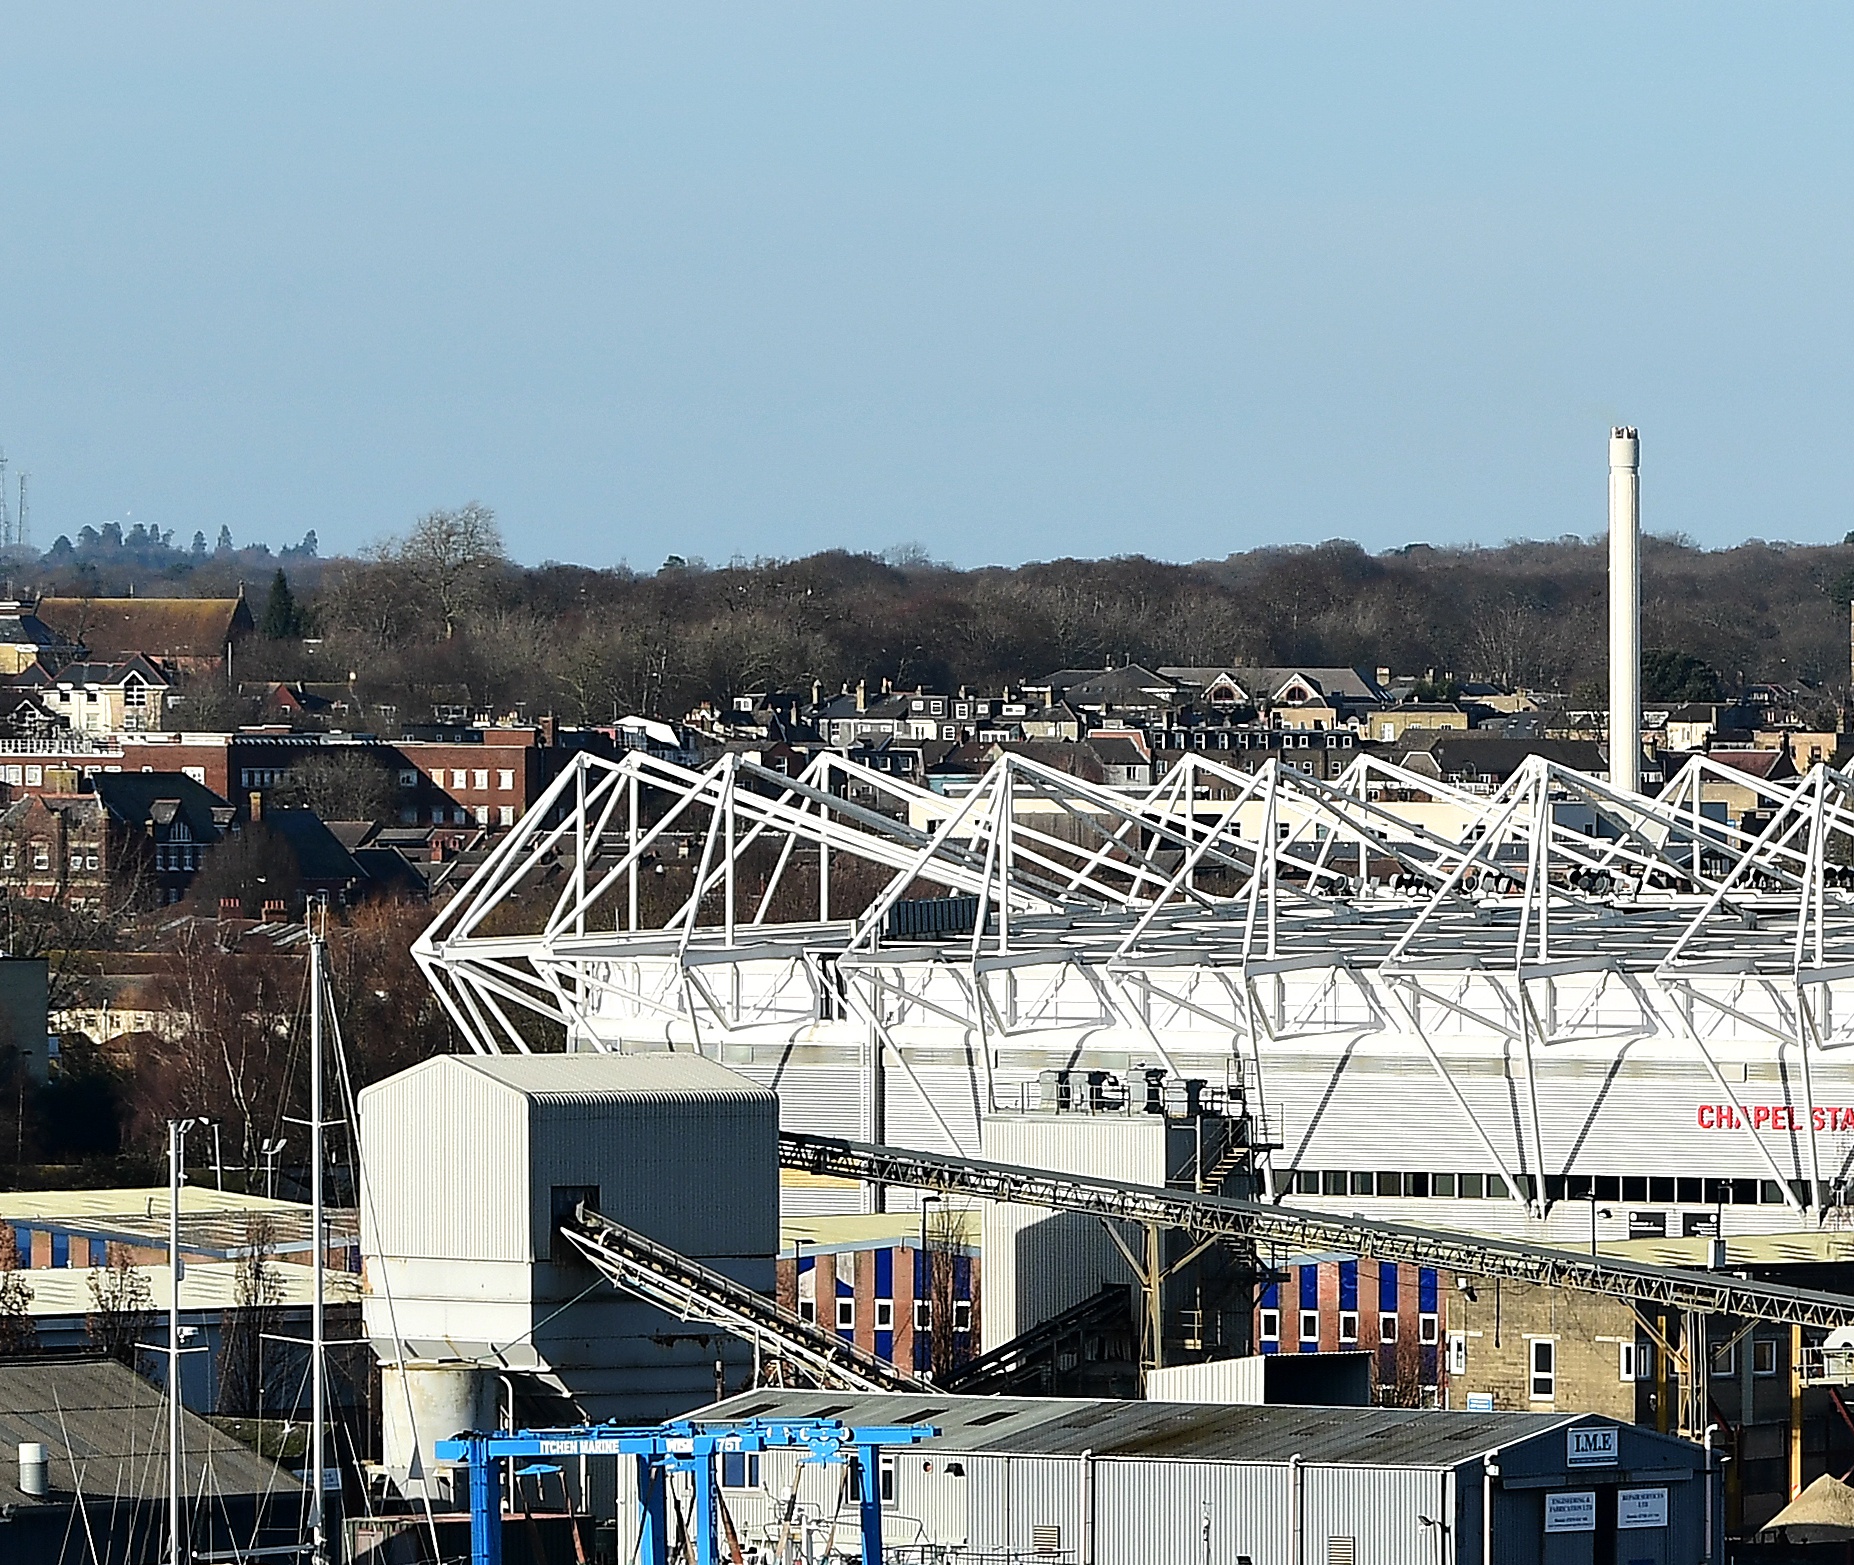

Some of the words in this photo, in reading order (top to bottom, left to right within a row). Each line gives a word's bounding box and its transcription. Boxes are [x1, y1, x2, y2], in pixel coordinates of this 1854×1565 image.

[1698, 1105, 1803, 1131] CHAPEL
[540, 1440, 577, 1454] ITCHEN
[580, 1440, 619, 1453] MARINE
[717, 1437, 742, 1451] 75T
[1575, 1433, 1612, 1452] I.M.E
